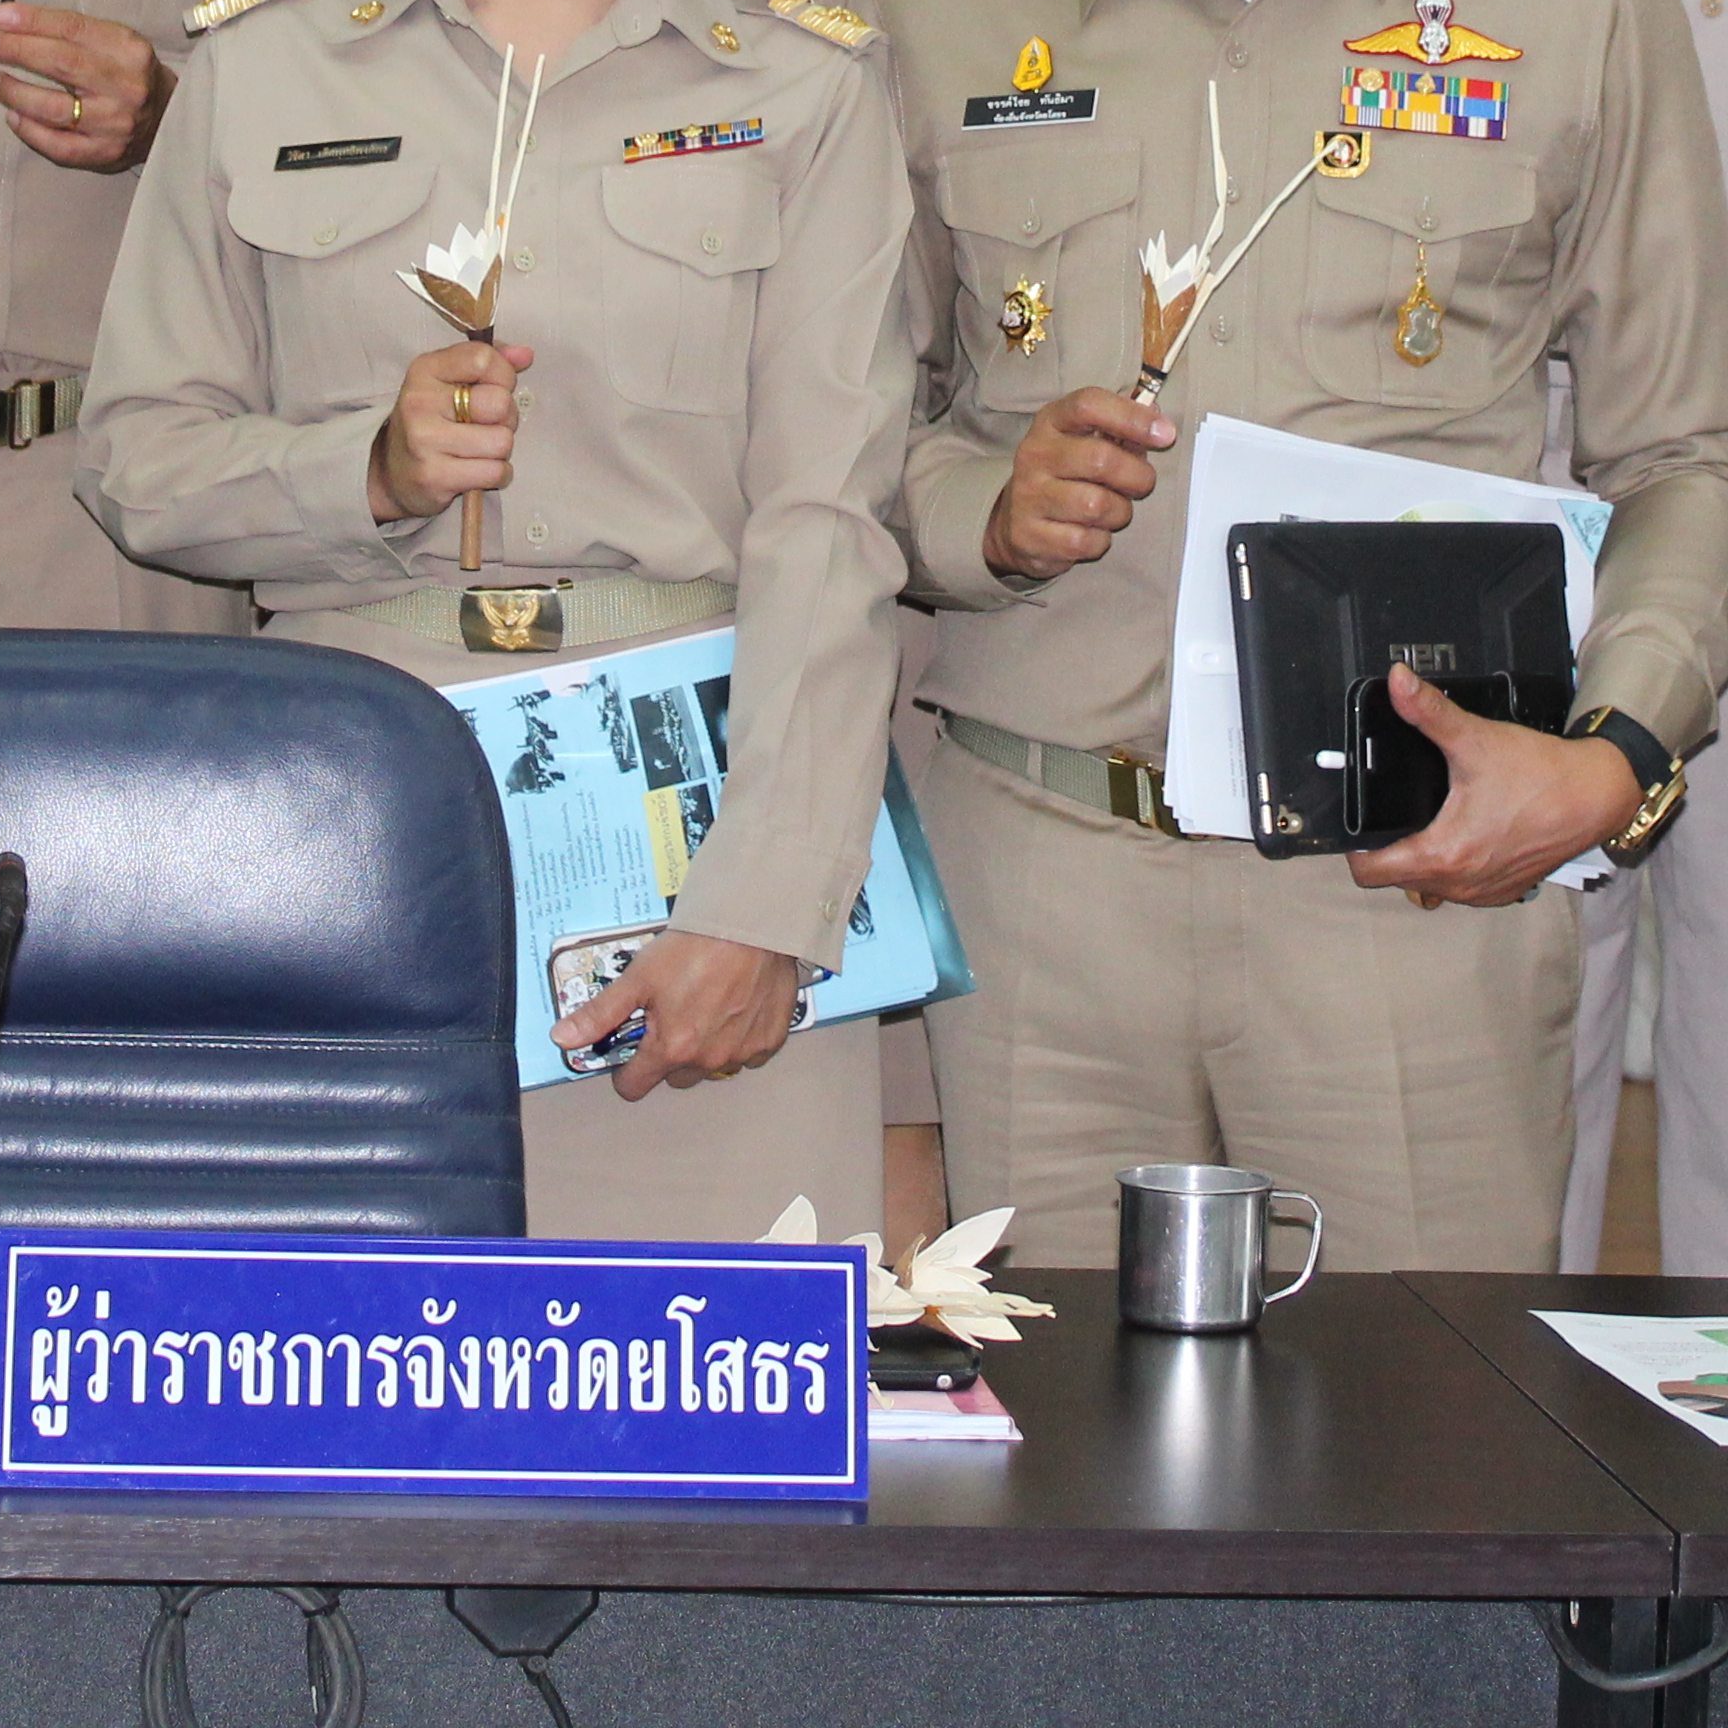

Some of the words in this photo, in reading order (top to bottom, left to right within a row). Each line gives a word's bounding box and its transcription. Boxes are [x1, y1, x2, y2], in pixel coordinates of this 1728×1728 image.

[30, 1284, 830, 1437] ผู้ว่าราชการจังหวัดยโสธร
